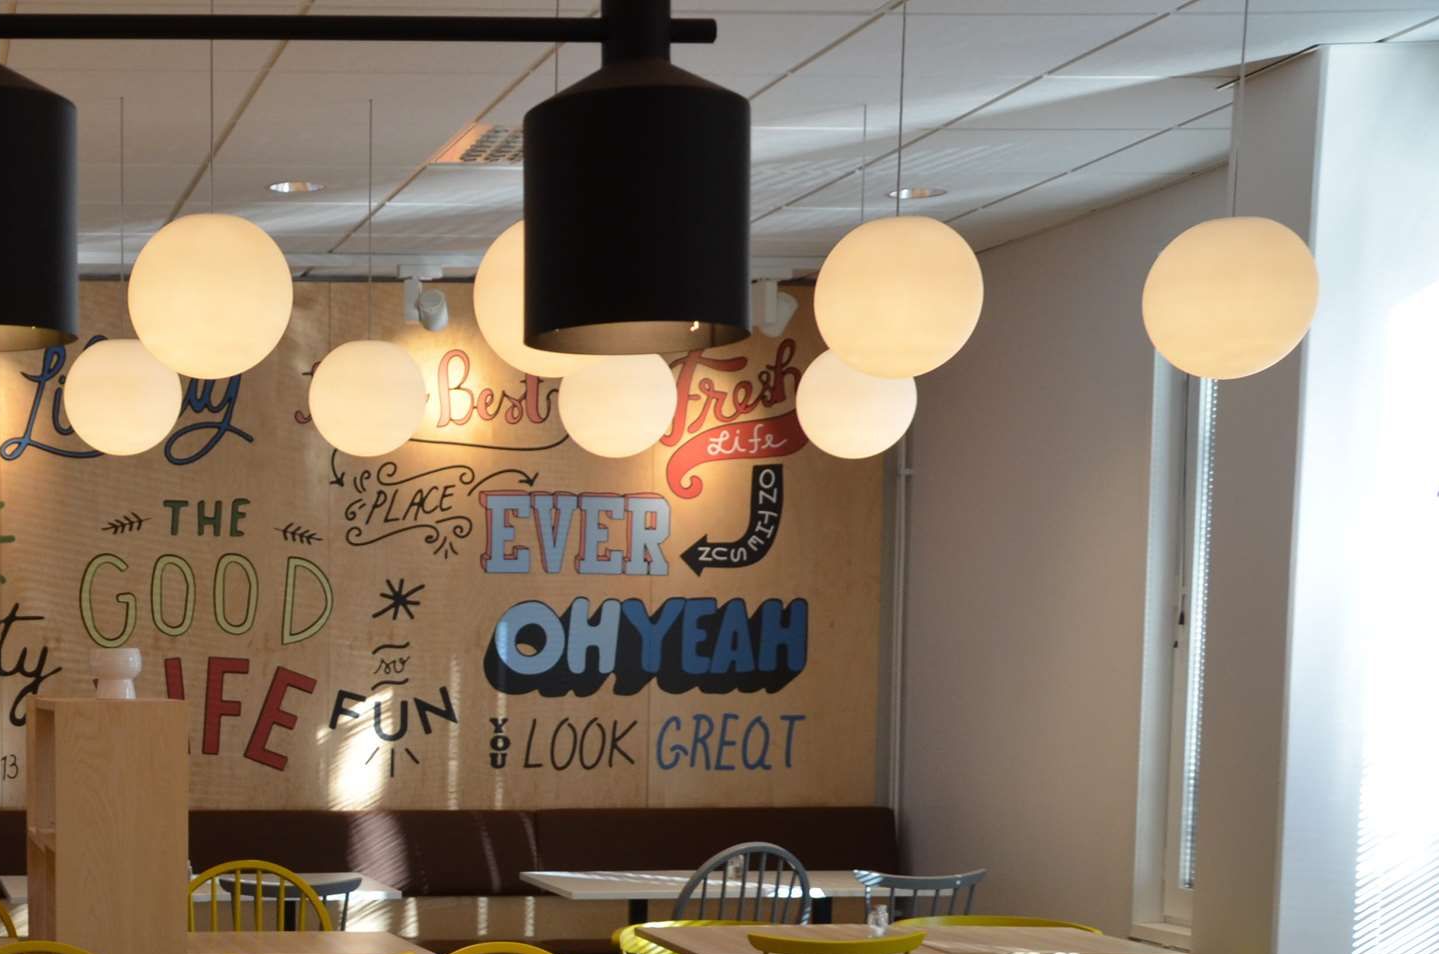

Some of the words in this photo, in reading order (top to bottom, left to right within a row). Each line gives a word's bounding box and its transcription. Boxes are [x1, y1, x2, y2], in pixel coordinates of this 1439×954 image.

[437, 349, 546, 428] Best
[660, 338, 803, 447] Fresh
[707, 424, 787, 455] Life
[366, 485, 456, 525] PLACE
[758, 469, 778, 504] ON
[162, 498, 252, 537] THE
[480, 490, 670, 576] EVER
[747, 510, 778, 551] THE
[79, 553, 333, 649] GOOD
[485, 597, 621, 692] OH
[621, 597, 808, 694] YEAH
[329, 686, 458, 741] FUN
[0, 754, 19, 780] 13
[489, 718, 511, 769] YOU
[523, 717, 638, 771] LOOK
